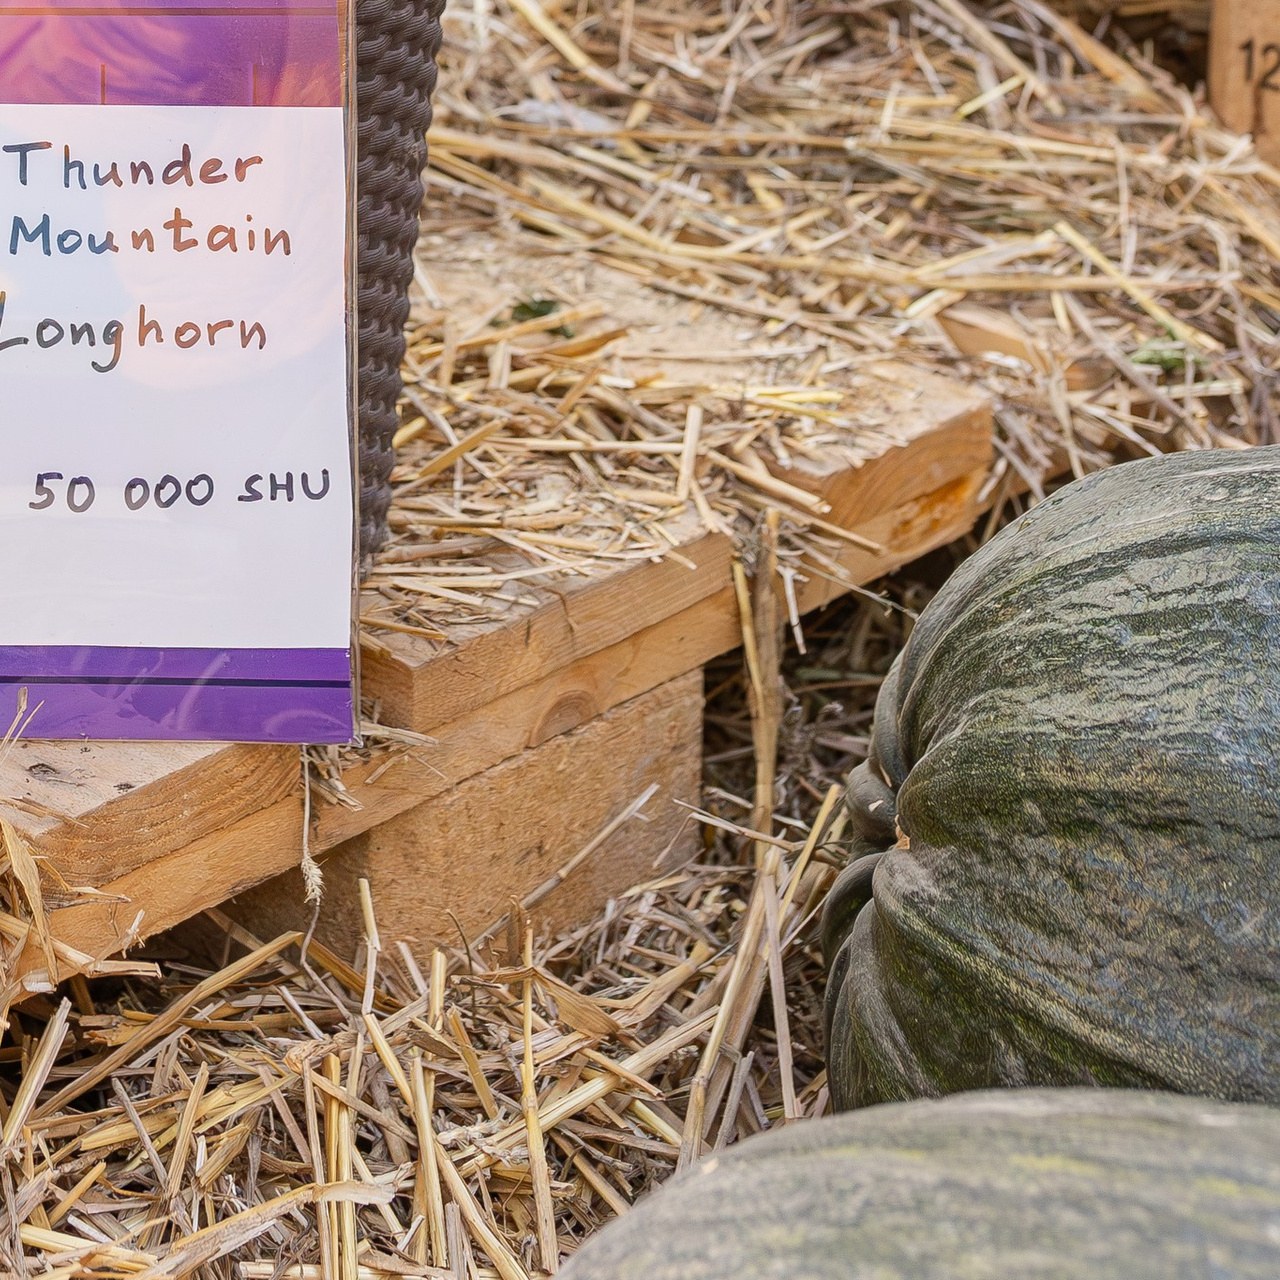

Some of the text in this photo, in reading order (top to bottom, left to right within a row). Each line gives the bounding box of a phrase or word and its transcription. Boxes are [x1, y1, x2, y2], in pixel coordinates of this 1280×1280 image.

[2, 141, 263, 189] Thunder
[9, 207, 291, 255] Mountain
[28, 468, 330, 513] 50 000 SHU
